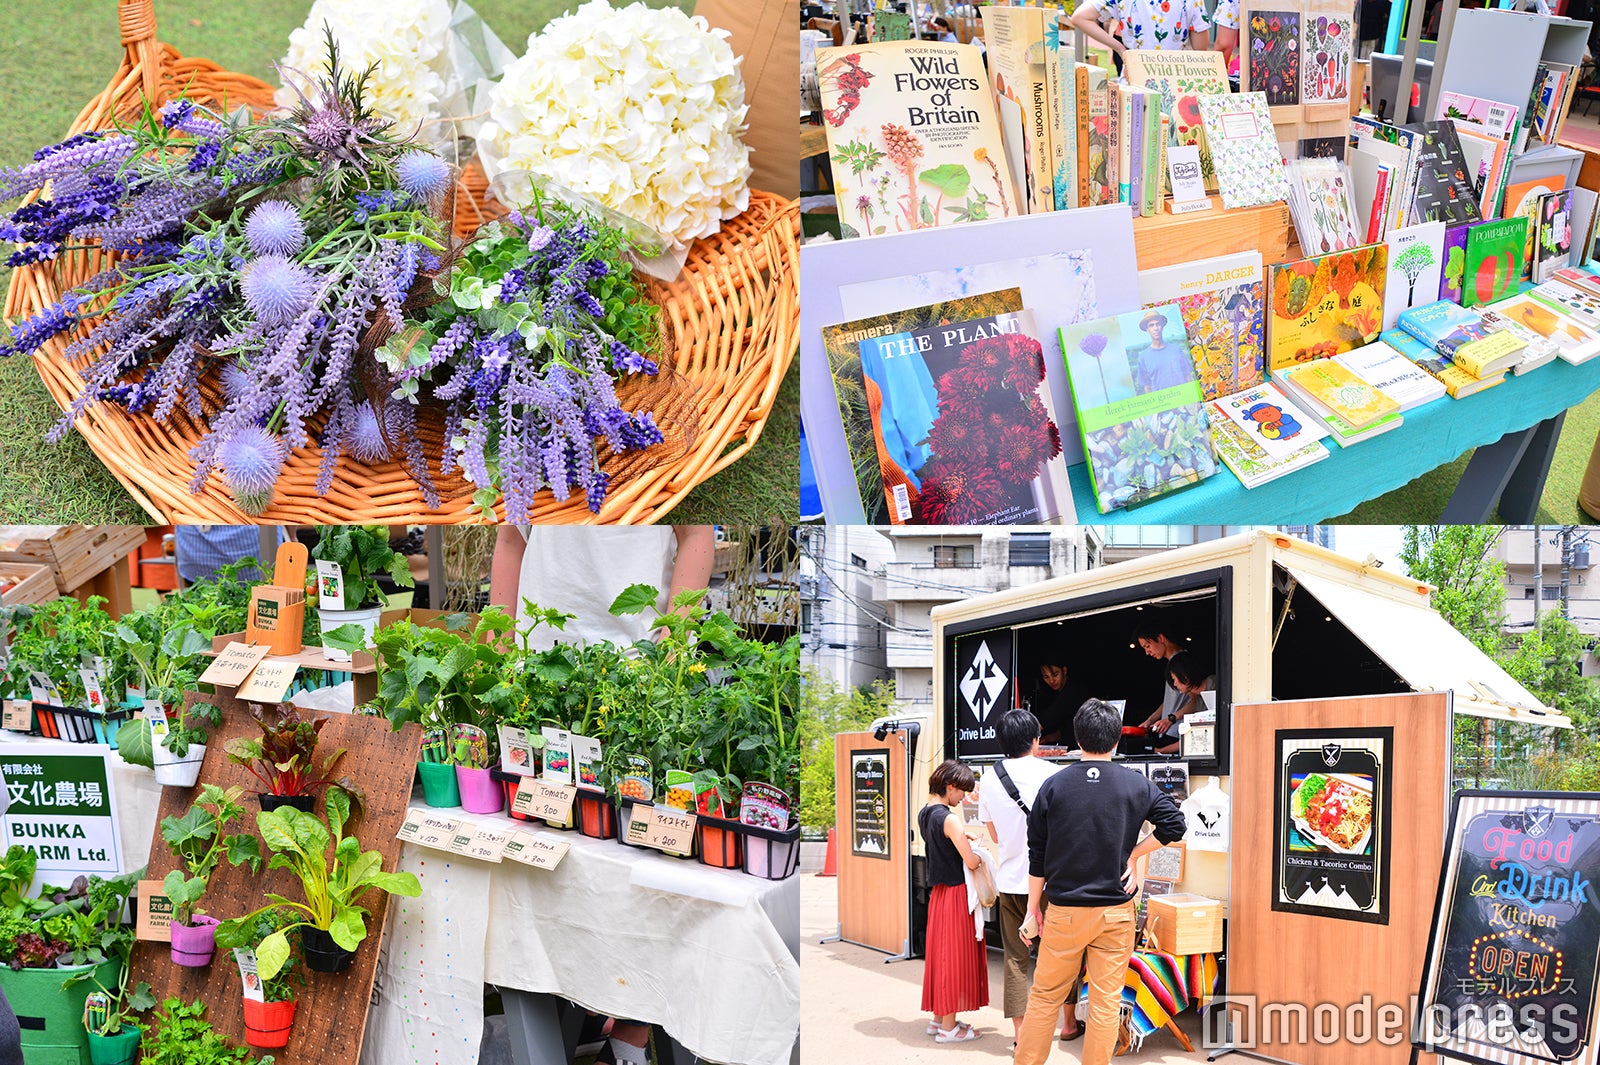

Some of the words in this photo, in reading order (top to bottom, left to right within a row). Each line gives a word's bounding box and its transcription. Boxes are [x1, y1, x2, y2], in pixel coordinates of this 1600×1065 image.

[909, 56, 960, 75] Wild
[1140, 53, 1156, 63] The
[1156, 54, 1185, 63] Oxford
[1187, 54, 1209, 63] Book
[1209, 54, 1216, 63] of
[1143, 63, 1172, 76] Wild
[1175, 65, 1218, 76] Flowers
[894, 73, 980, 92] Flowers
[931, 88, 952, 106] of
[908, 106, 981, 126] Britain
[1033, 82, 1045, 138] Mushrooms
[1180, 280, 1204, 290] henry
[1205, 265, 1255, 285] DARGER
[834, 323, 895, 346] camera
[880, 334, 933, 360] THE
[942, 317, 1020, 348] PLANT
[1105, 403, 1126, 416] derek
[1158, 389, 1182, 404] garden
[1231, 390, 1270, 409] GARDEN
[985, 510, 1010, 521] Elephant
[1010, 505, 1020, 513] Ear
[998, 513, 1022, 524] ordinary
[1022, 506, 1040, 518] plants
[226, 649, 257, 660] Tomato
[2, 763, 44, 775] 有限会社
[6, 780, 103, 808] 文化農場
[540, 787, 569, 800] Tomato
[543, 804, 558, 815] 300
[11, 822, 86, 839] BUNKA
[662, 835, 677, 846] 200
[1483, 827, 1574, 870] Food
[22, 844, 71, 861] ARM
[77, 847, 111, 862] Ltd.
[1287, 857, 1312, 867] Chicken
[1320, 859, 1348, 869] Tacorice
[1348, 861, 1372, 871] Combo
[1497, 862, 1590, 909] Drink
[1489, 902, 1557, 929] Kitchen
[1481, 945, 1549, 979] OPEN
